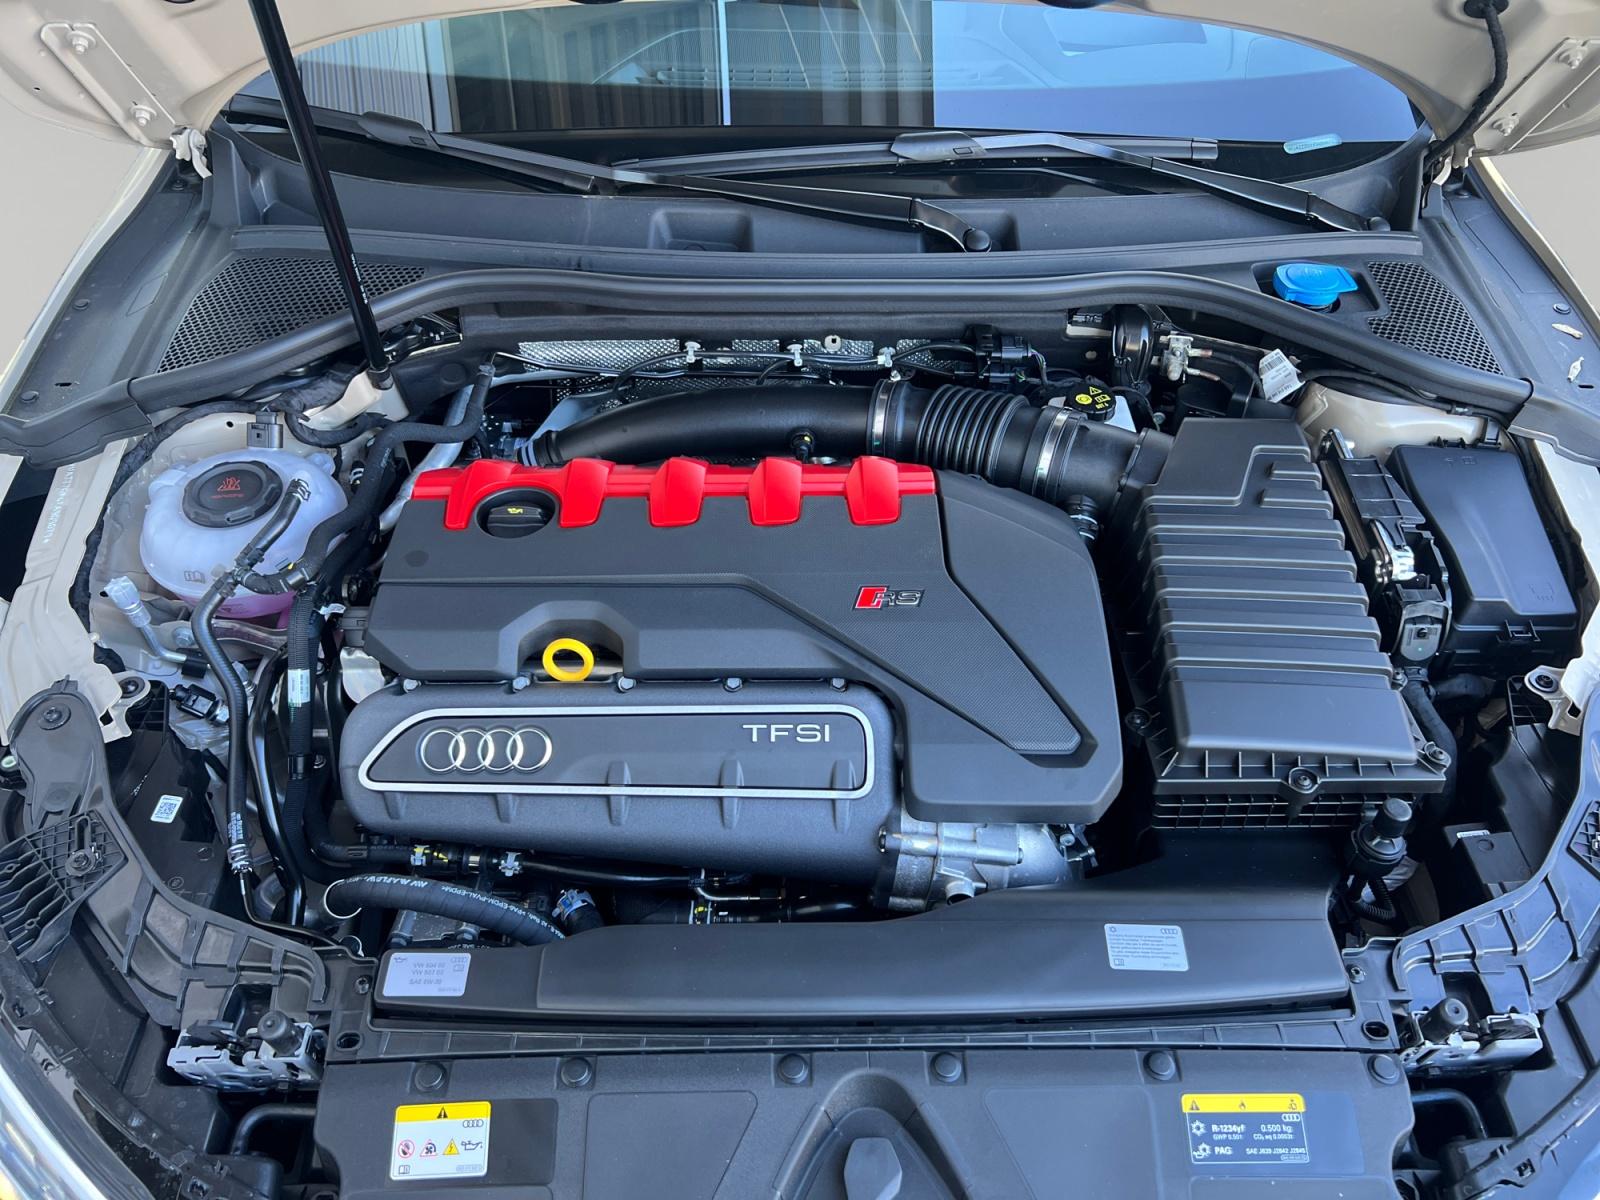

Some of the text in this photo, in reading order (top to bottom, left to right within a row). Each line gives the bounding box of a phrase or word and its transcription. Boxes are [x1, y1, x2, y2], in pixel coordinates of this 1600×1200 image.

[870, 589, 922, 606] RS
[742, 724, 830, 742] TFSI
[1211, 1124, 1293, 1134] R-1234yf 0.500 kg
[1214, 1146, 1232, 1155] PAG
